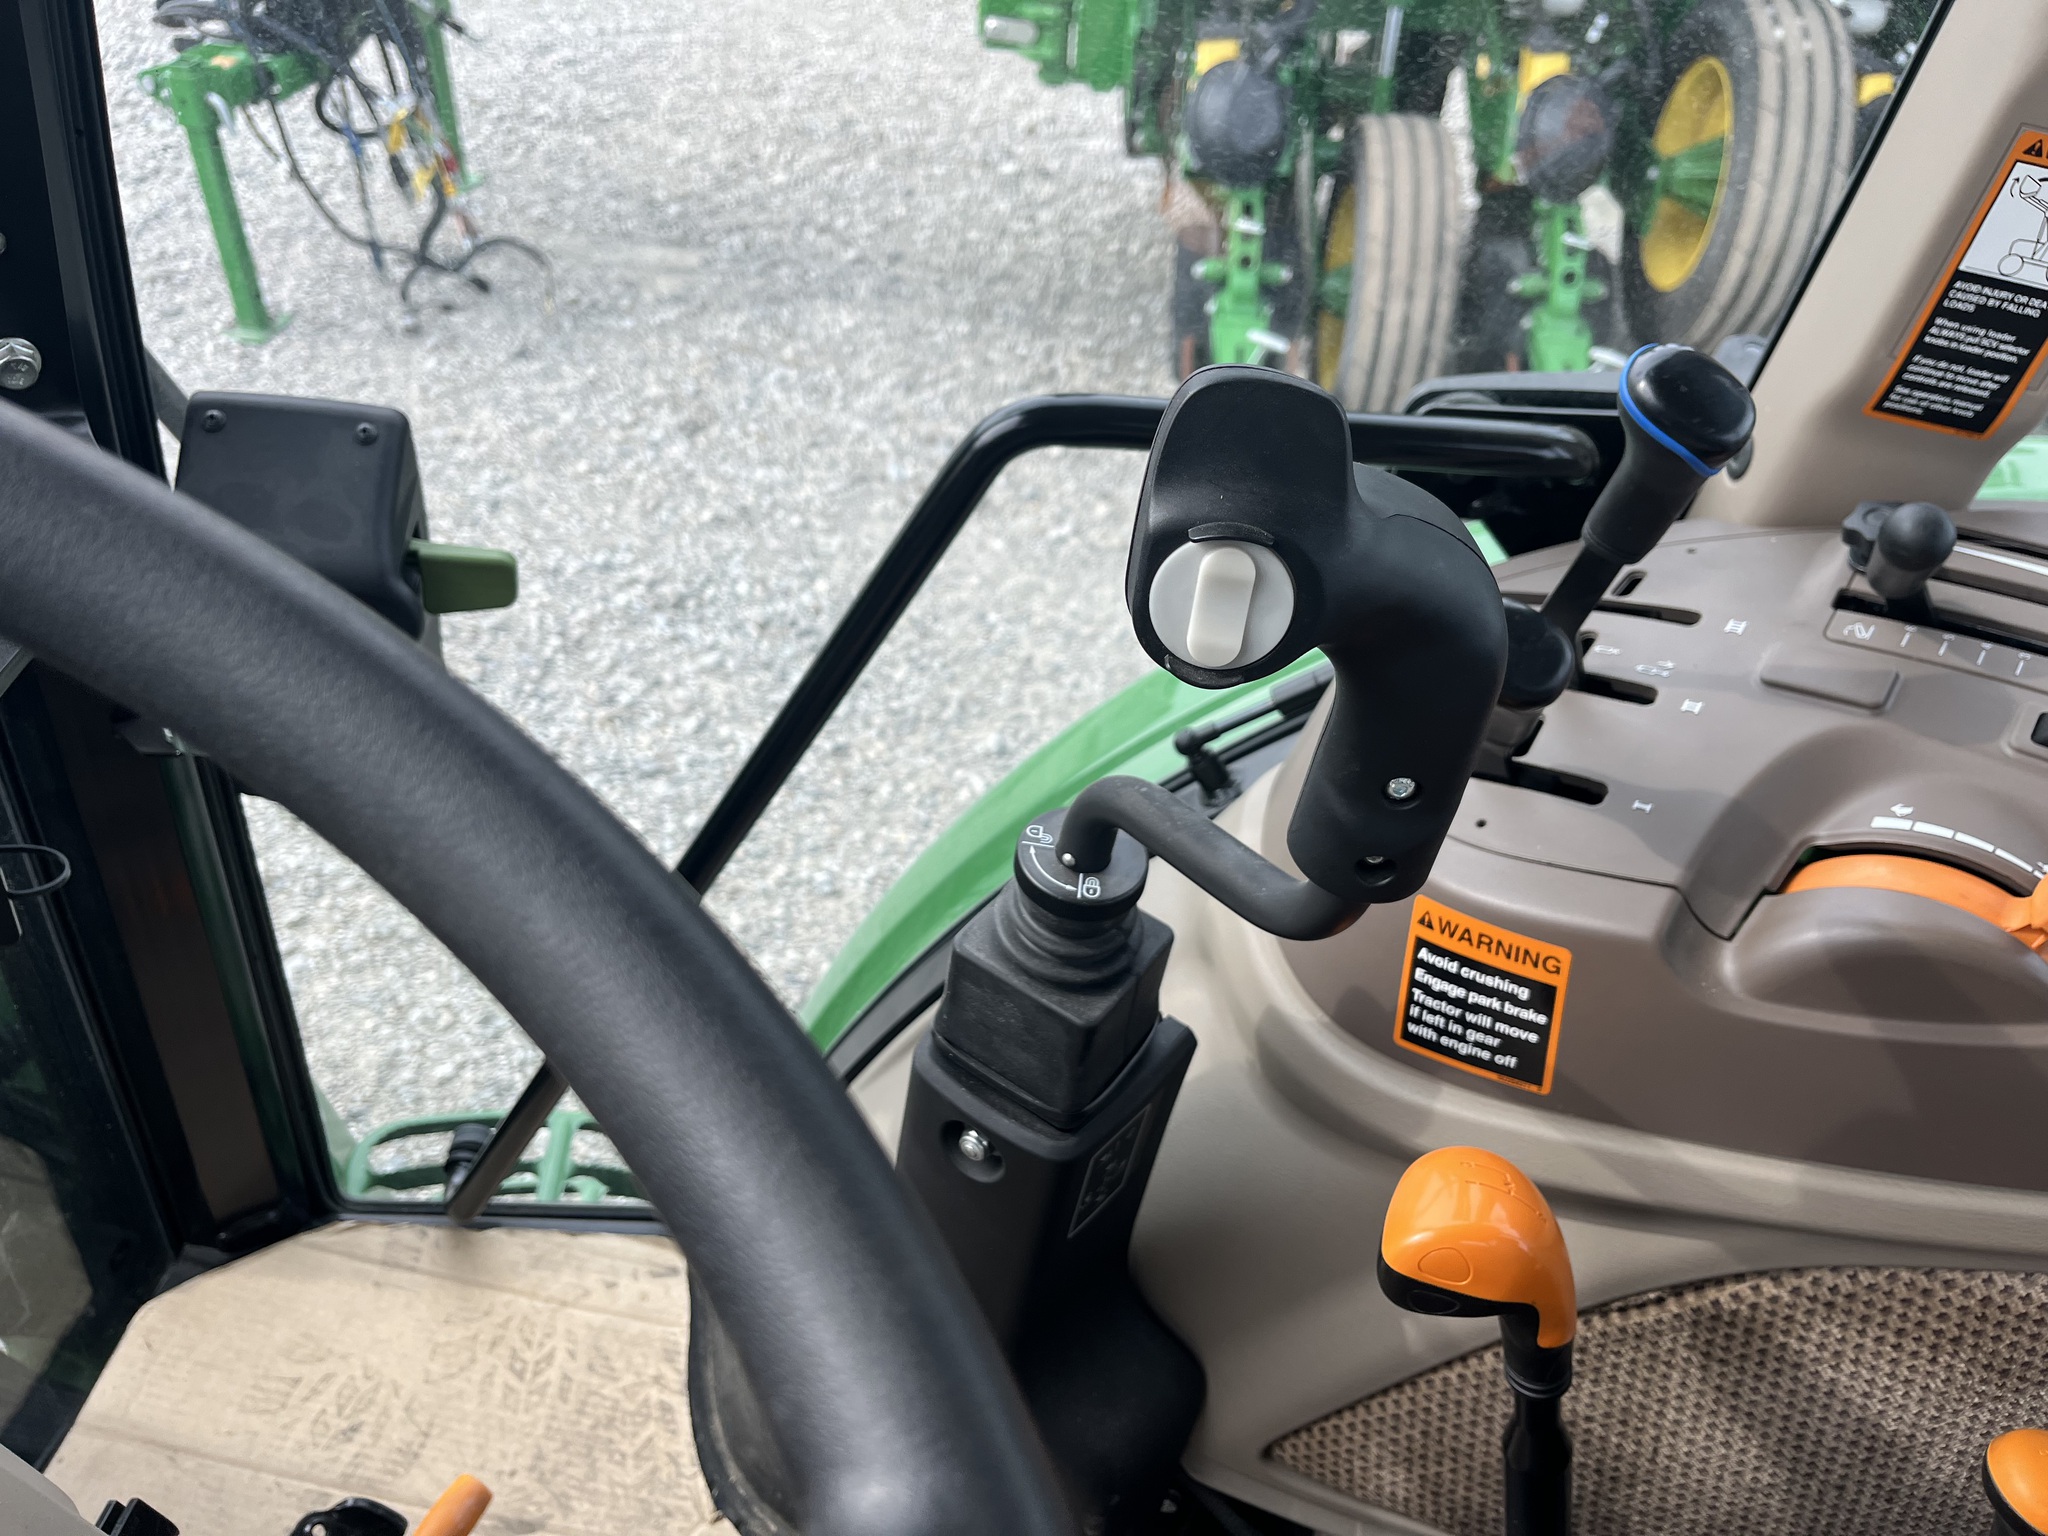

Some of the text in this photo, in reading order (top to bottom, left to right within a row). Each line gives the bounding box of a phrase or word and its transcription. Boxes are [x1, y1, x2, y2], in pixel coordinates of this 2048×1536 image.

[1942, 298, 1976, 313] LOADS
[1948, 289, 2041, 318] CAUSED BY FALLING
[1953, 280, 2048, 310] AVOID INJURY OR DEA
[1934, 317, 1960, 330] When
[1438, 916, 1561, 975] WARNING
[1414, 967, 1549, 1025] Engage park brake
[1417, 947, 1531, 1001] Avoid crushing
[1409, 1004, 1503, 1047] if left in gear
[1412, 988, 1540, 1044] Tractor will move
[1407, 1021, 1519, 1069] with engine off
